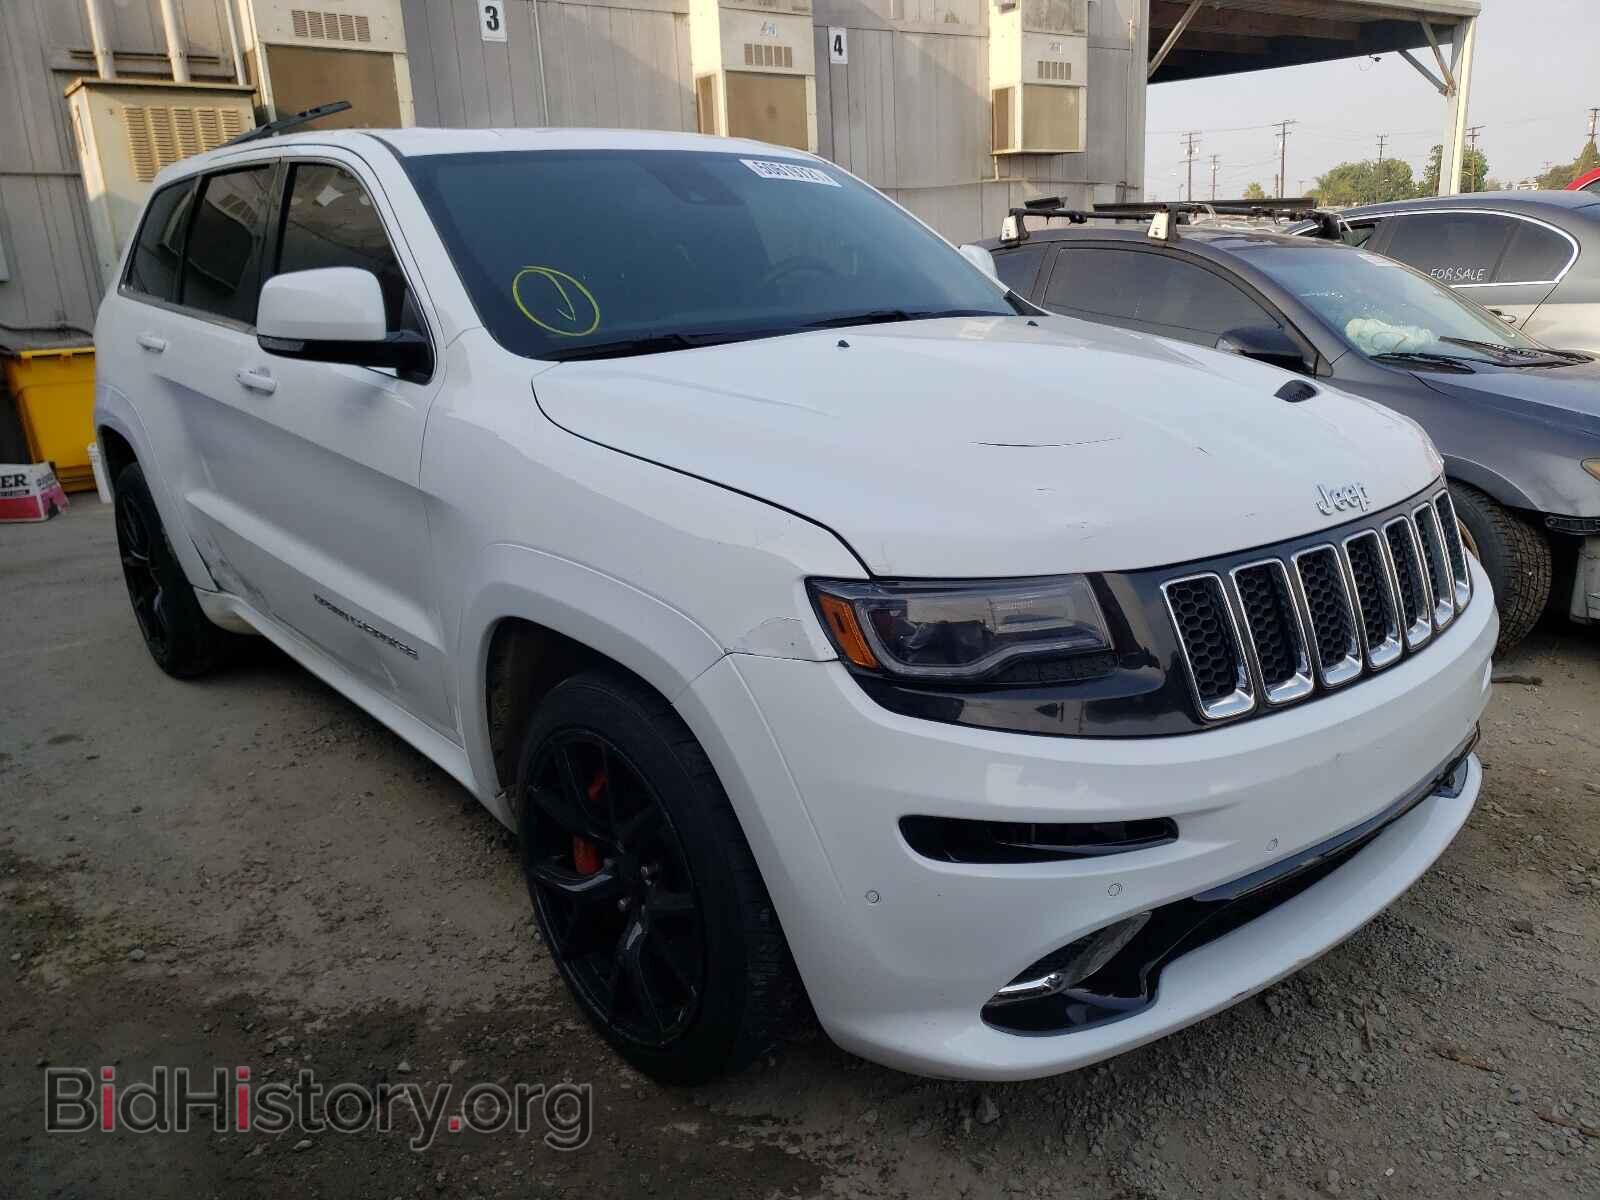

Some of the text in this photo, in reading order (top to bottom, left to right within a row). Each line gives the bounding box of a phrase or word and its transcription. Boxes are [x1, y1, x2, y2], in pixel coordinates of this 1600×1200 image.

[485, 5, 499, 31] 3
[833, 34, 844, 56] 4
[1430, 267, 1488, 281] FOR SALE
[1315, 481, 1370, 516] Jeep
